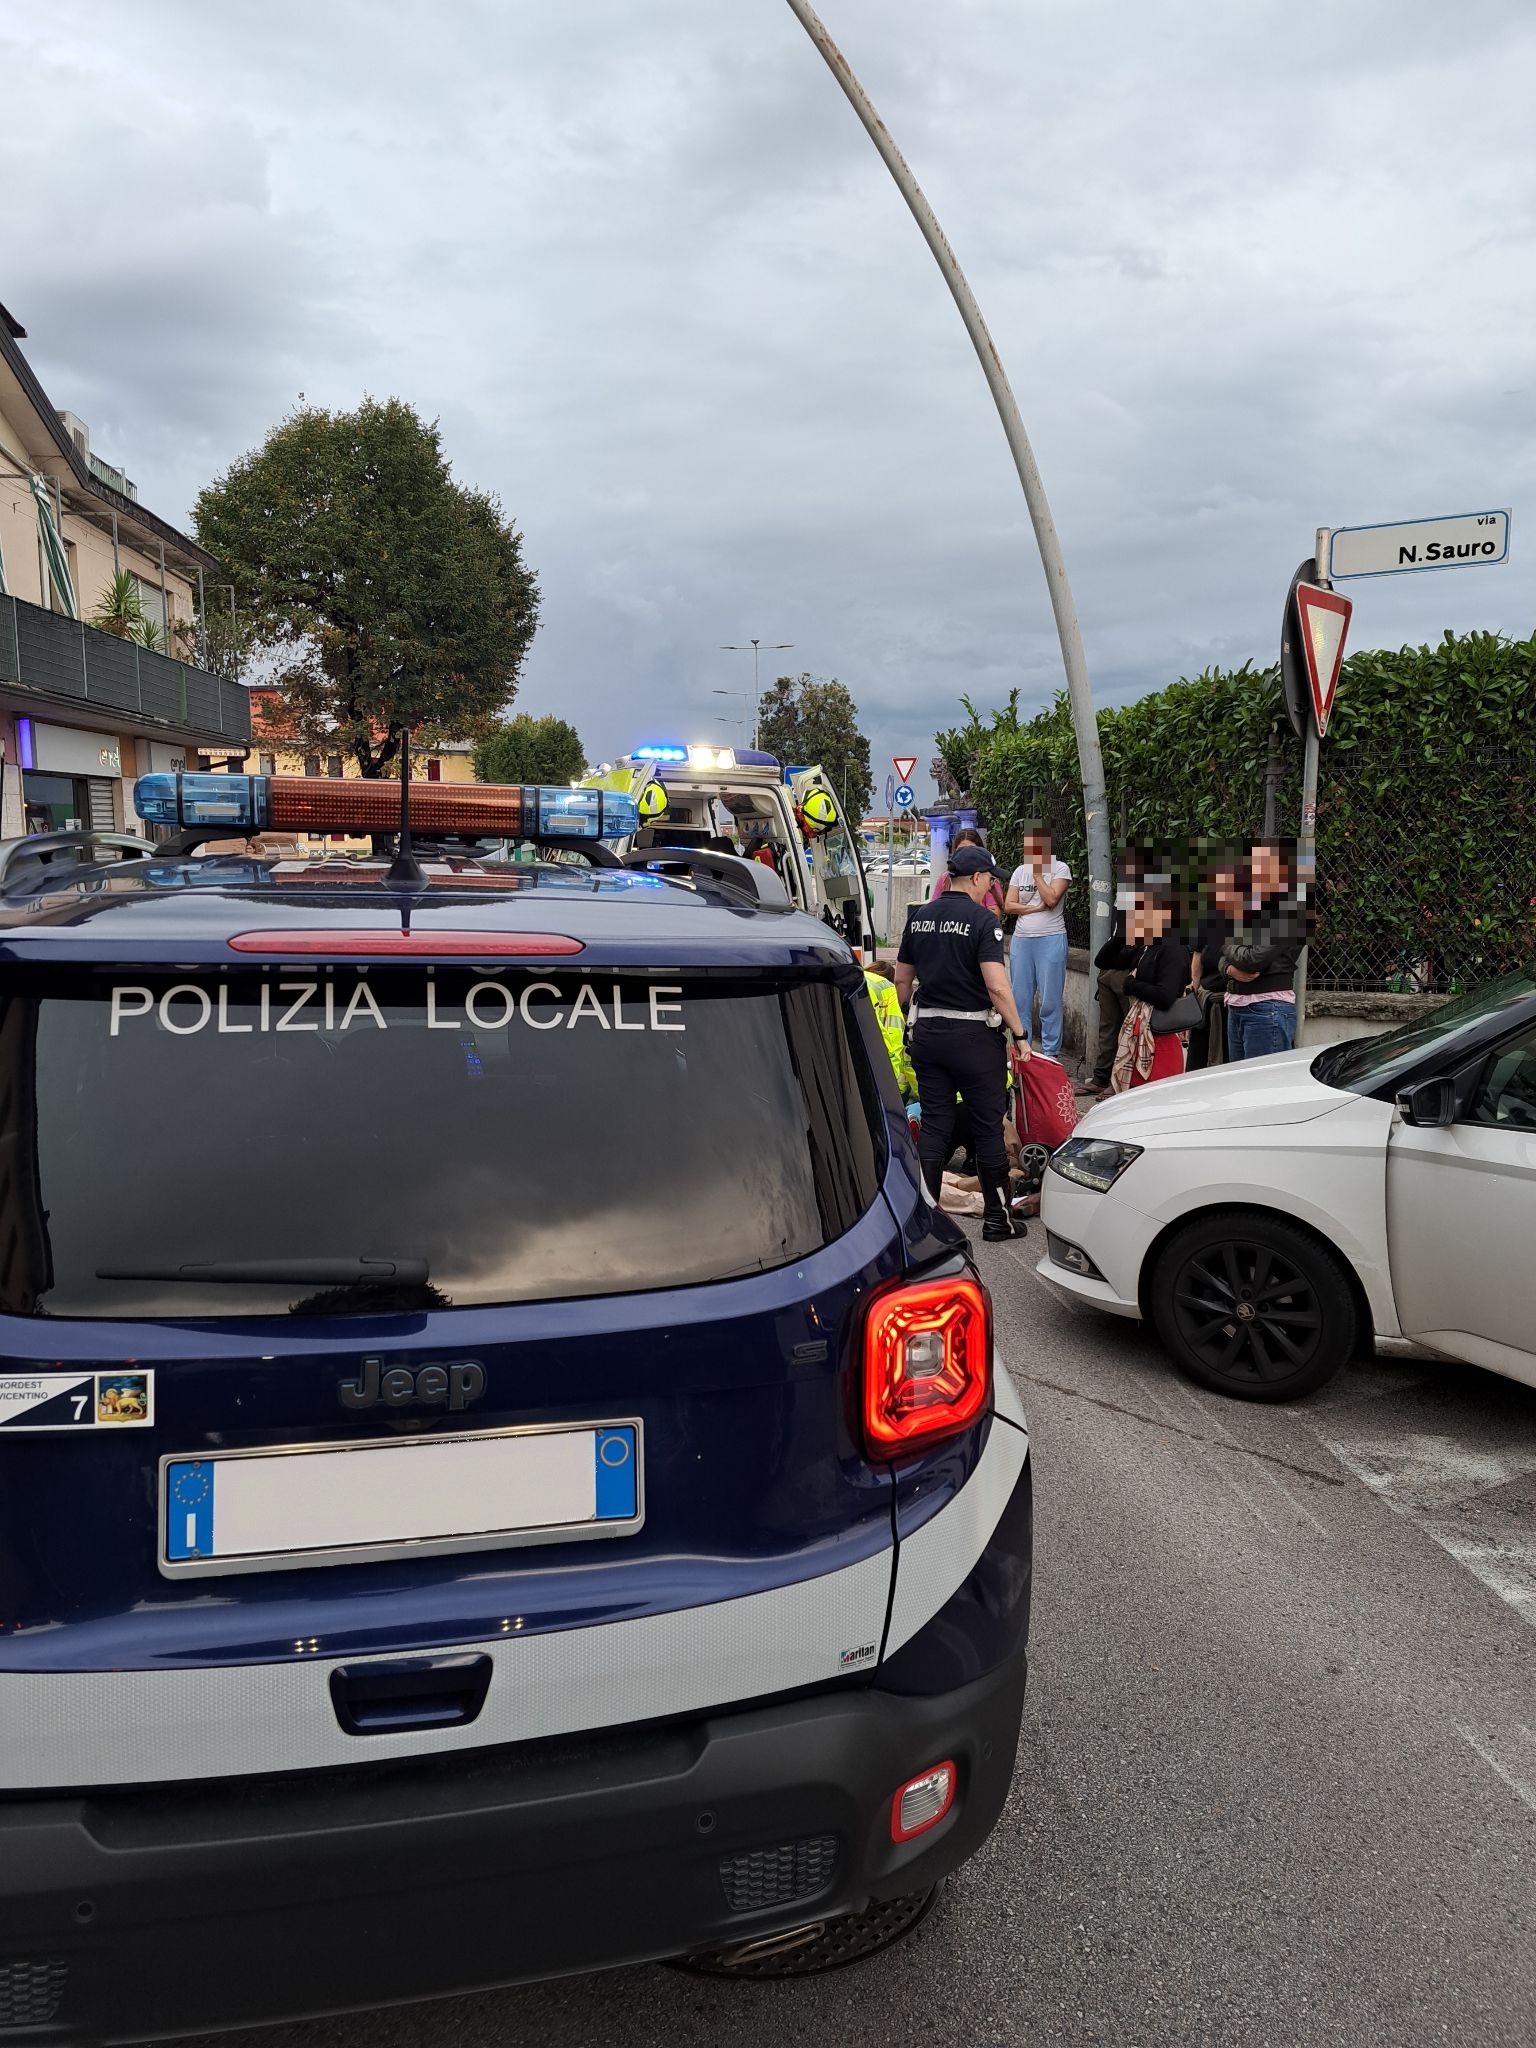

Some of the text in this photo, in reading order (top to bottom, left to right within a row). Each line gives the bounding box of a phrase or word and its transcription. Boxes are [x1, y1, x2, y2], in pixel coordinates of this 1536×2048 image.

[1477, 516, 1496, 526] via
[1398, 541, 1496, 564] N.Sauro
[911, 920, 970, 936] POLIZIA LOCALE
[110, 981, 686, 1036] POLIZIA LOCALE
[339, 1358, 486, 1410] Jeep
[70, 1395, 88, 1421] 7
